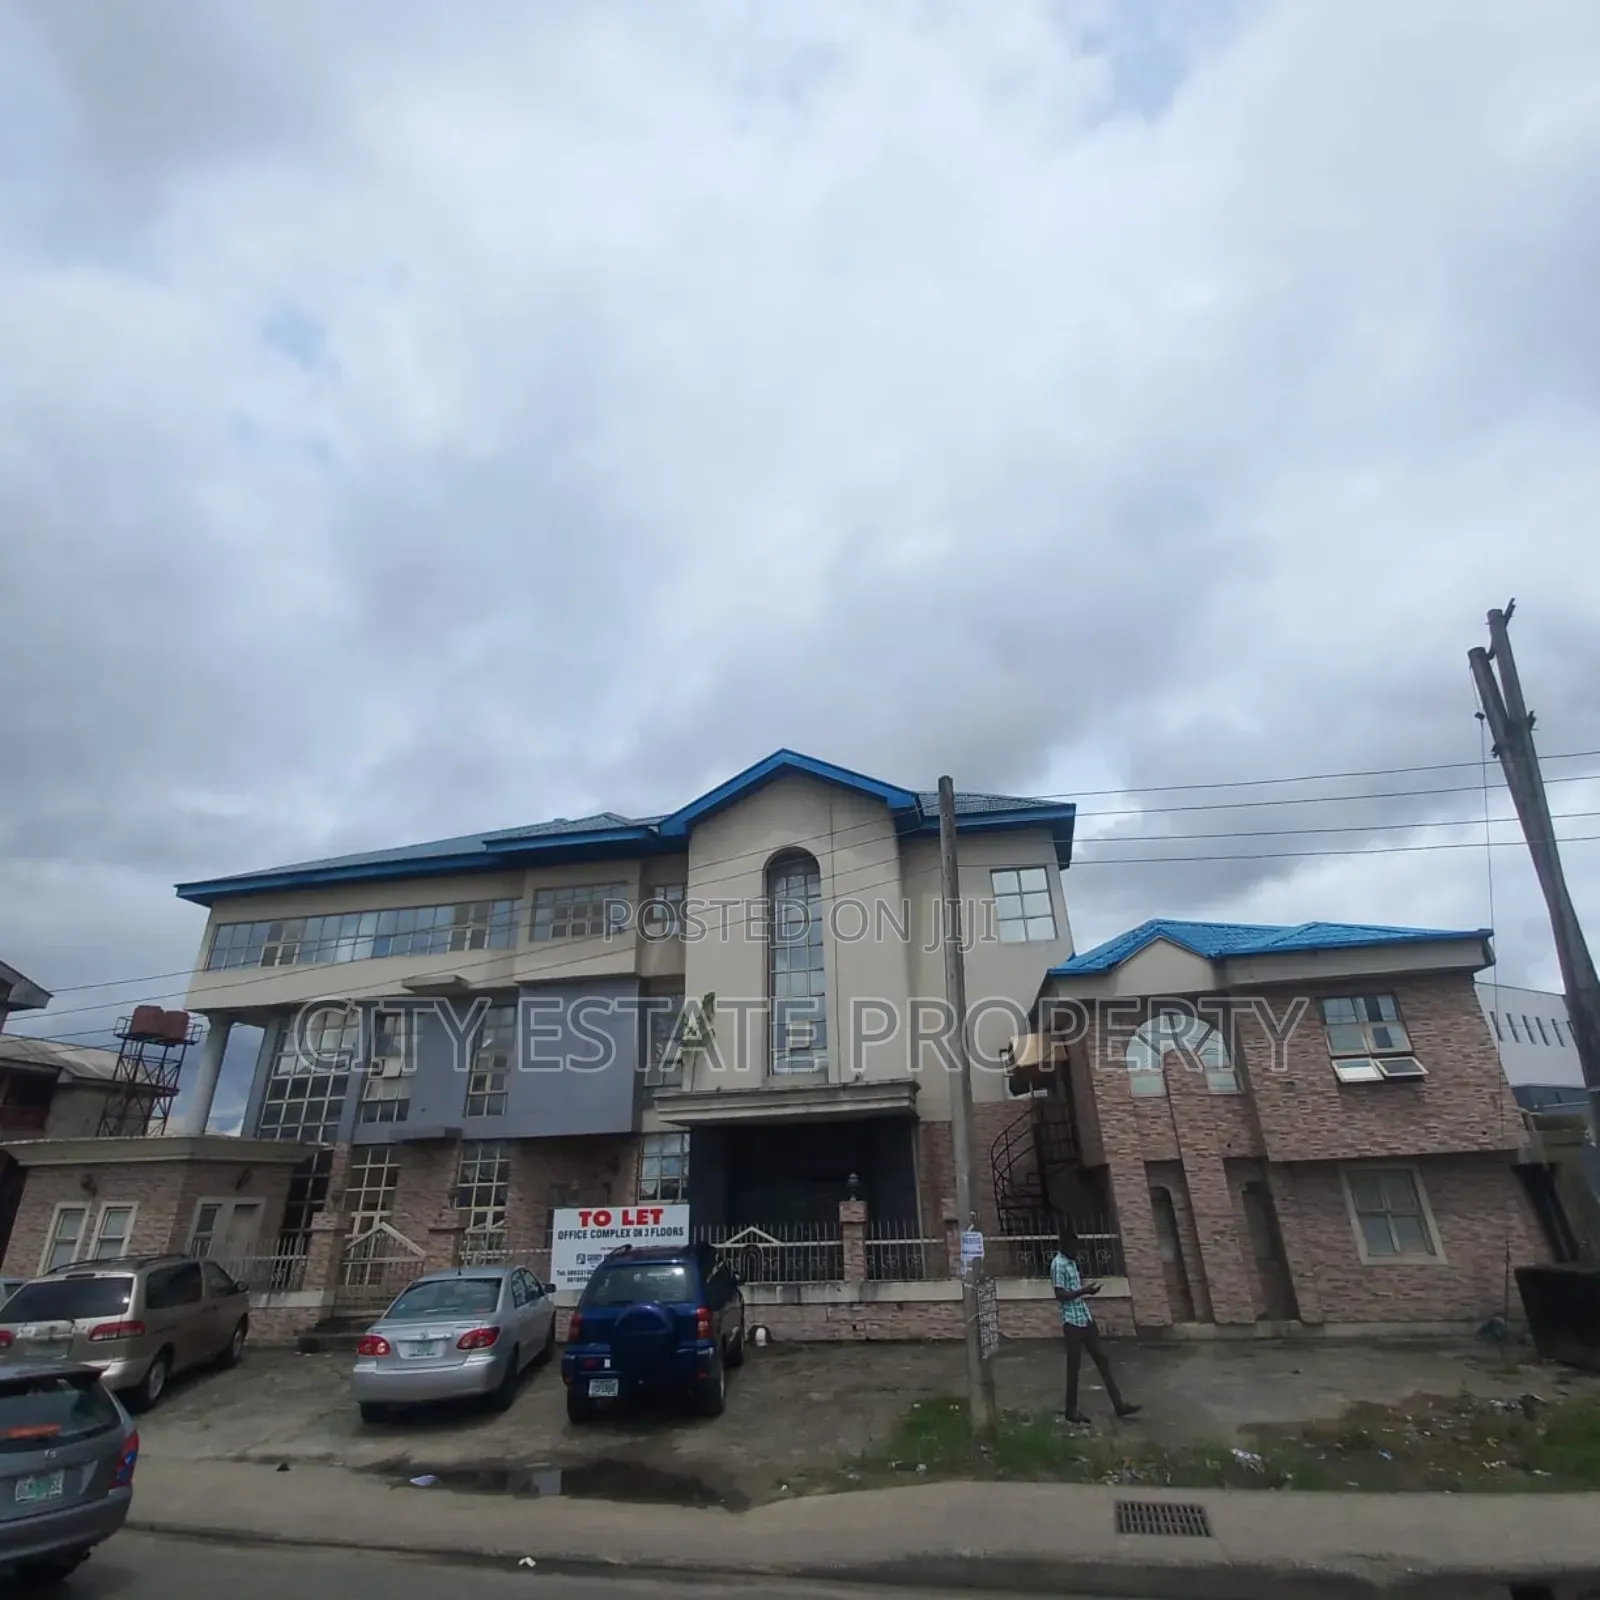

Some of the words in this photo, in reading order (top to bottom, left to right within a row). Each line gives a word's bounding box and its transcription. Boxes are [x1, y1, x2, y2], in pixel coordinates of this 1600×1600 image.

[579, 1210, 612, 1227] TO
[622, 1208, 664, 1226] LET
[558, 1229, 588, 1240] OFFICE
[590, 1228, 630, 1239] COMPLEX
[633, 1228, 643, 1238] ON
[644, 1228, 649, 1237] 3
[650, 1226, 684, 1238] FLOORS
